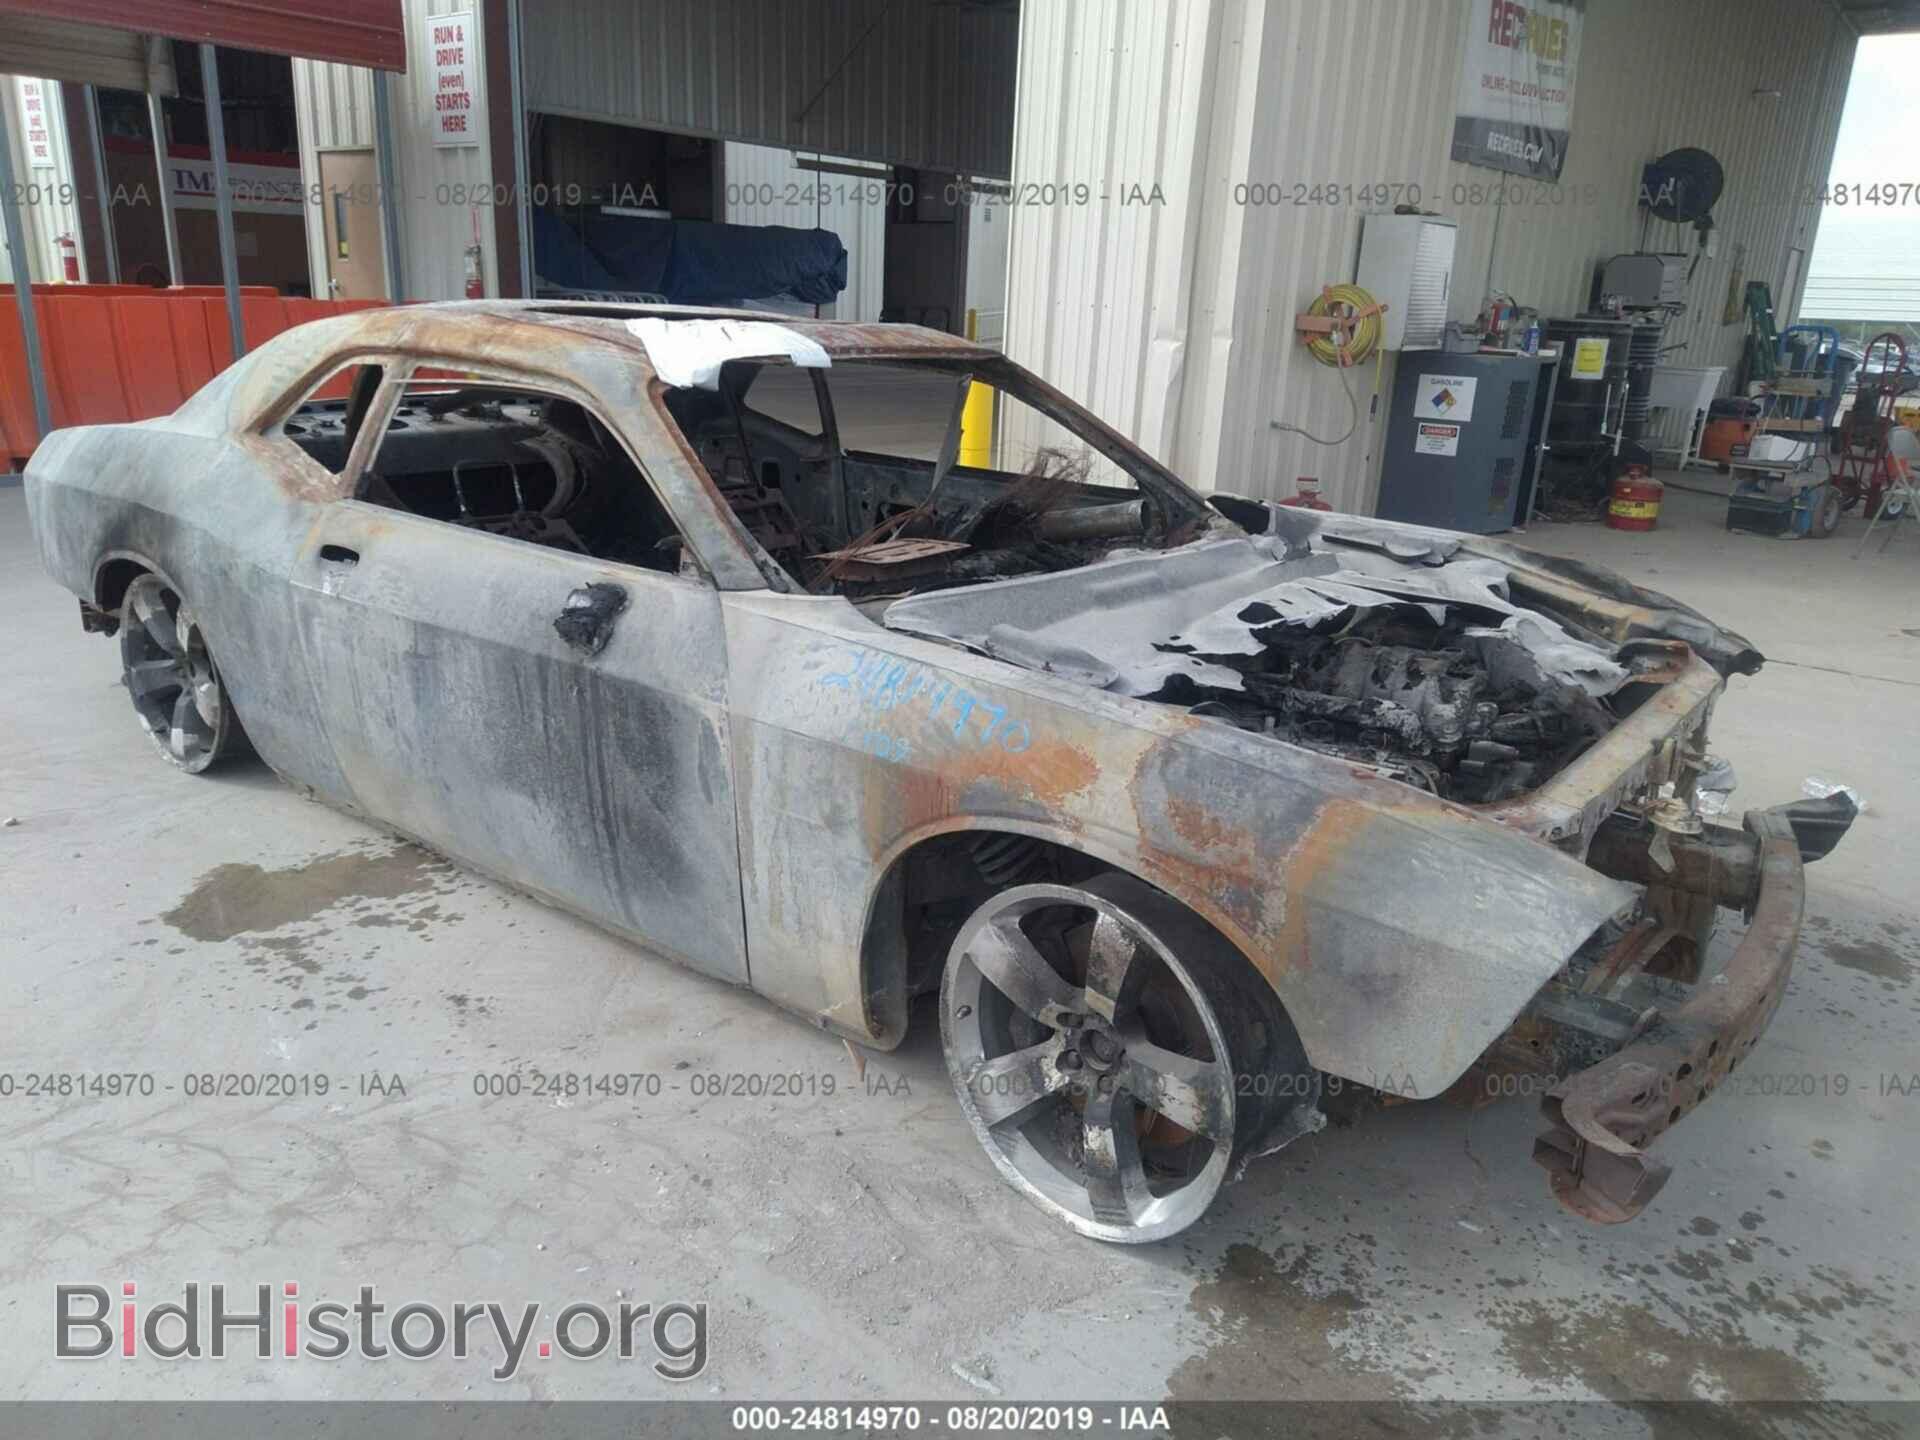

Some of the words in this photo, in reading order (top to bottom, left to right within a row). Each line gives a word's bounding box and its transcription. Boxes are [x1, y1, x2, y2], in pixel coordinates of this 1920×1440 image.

[433, 26, 454, 45] RUN
[456, 24, 464, 42] &
[436, 48, 464, 67] DRIVE
[438, 71, 465, 91] (even)
[435, 92, 471, 111] STARTS
[441, 115, 467, 132] HERE
